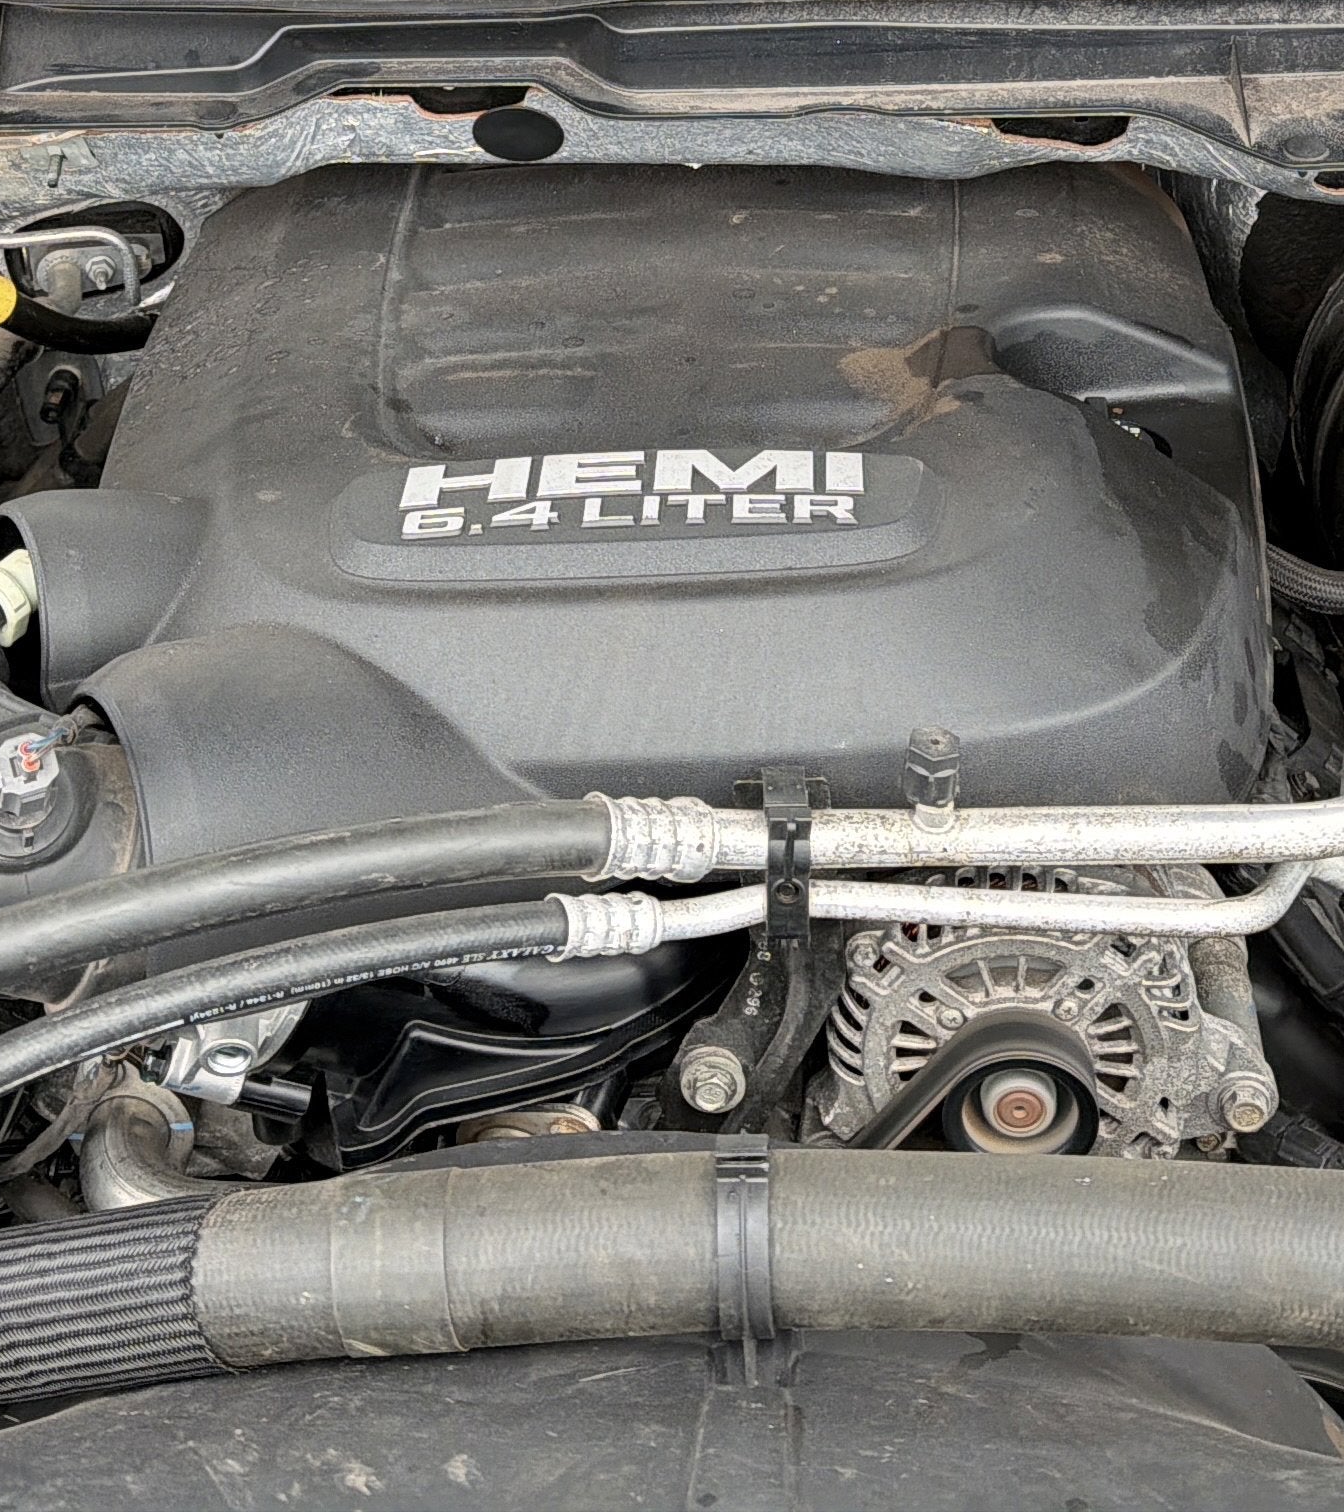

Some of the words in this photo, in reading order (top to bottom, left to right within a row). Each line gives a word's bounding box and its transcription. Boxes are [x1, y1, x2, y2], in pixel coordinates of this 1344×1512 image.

[399, 449, 864, 511] HEMI
[401, 500, 560, 540] 6.4
[581, 495, 859, 528] LITER
[460, 952, 485, 963] SLE
[485, 946, 554, 959] GALAXY
[376, 964, 408, 977] HOSE
[410, 960, 431, 969] A/C
[290, 978, 331, 993] (10mm)
[246, 991, 285, 1005] R-134a
